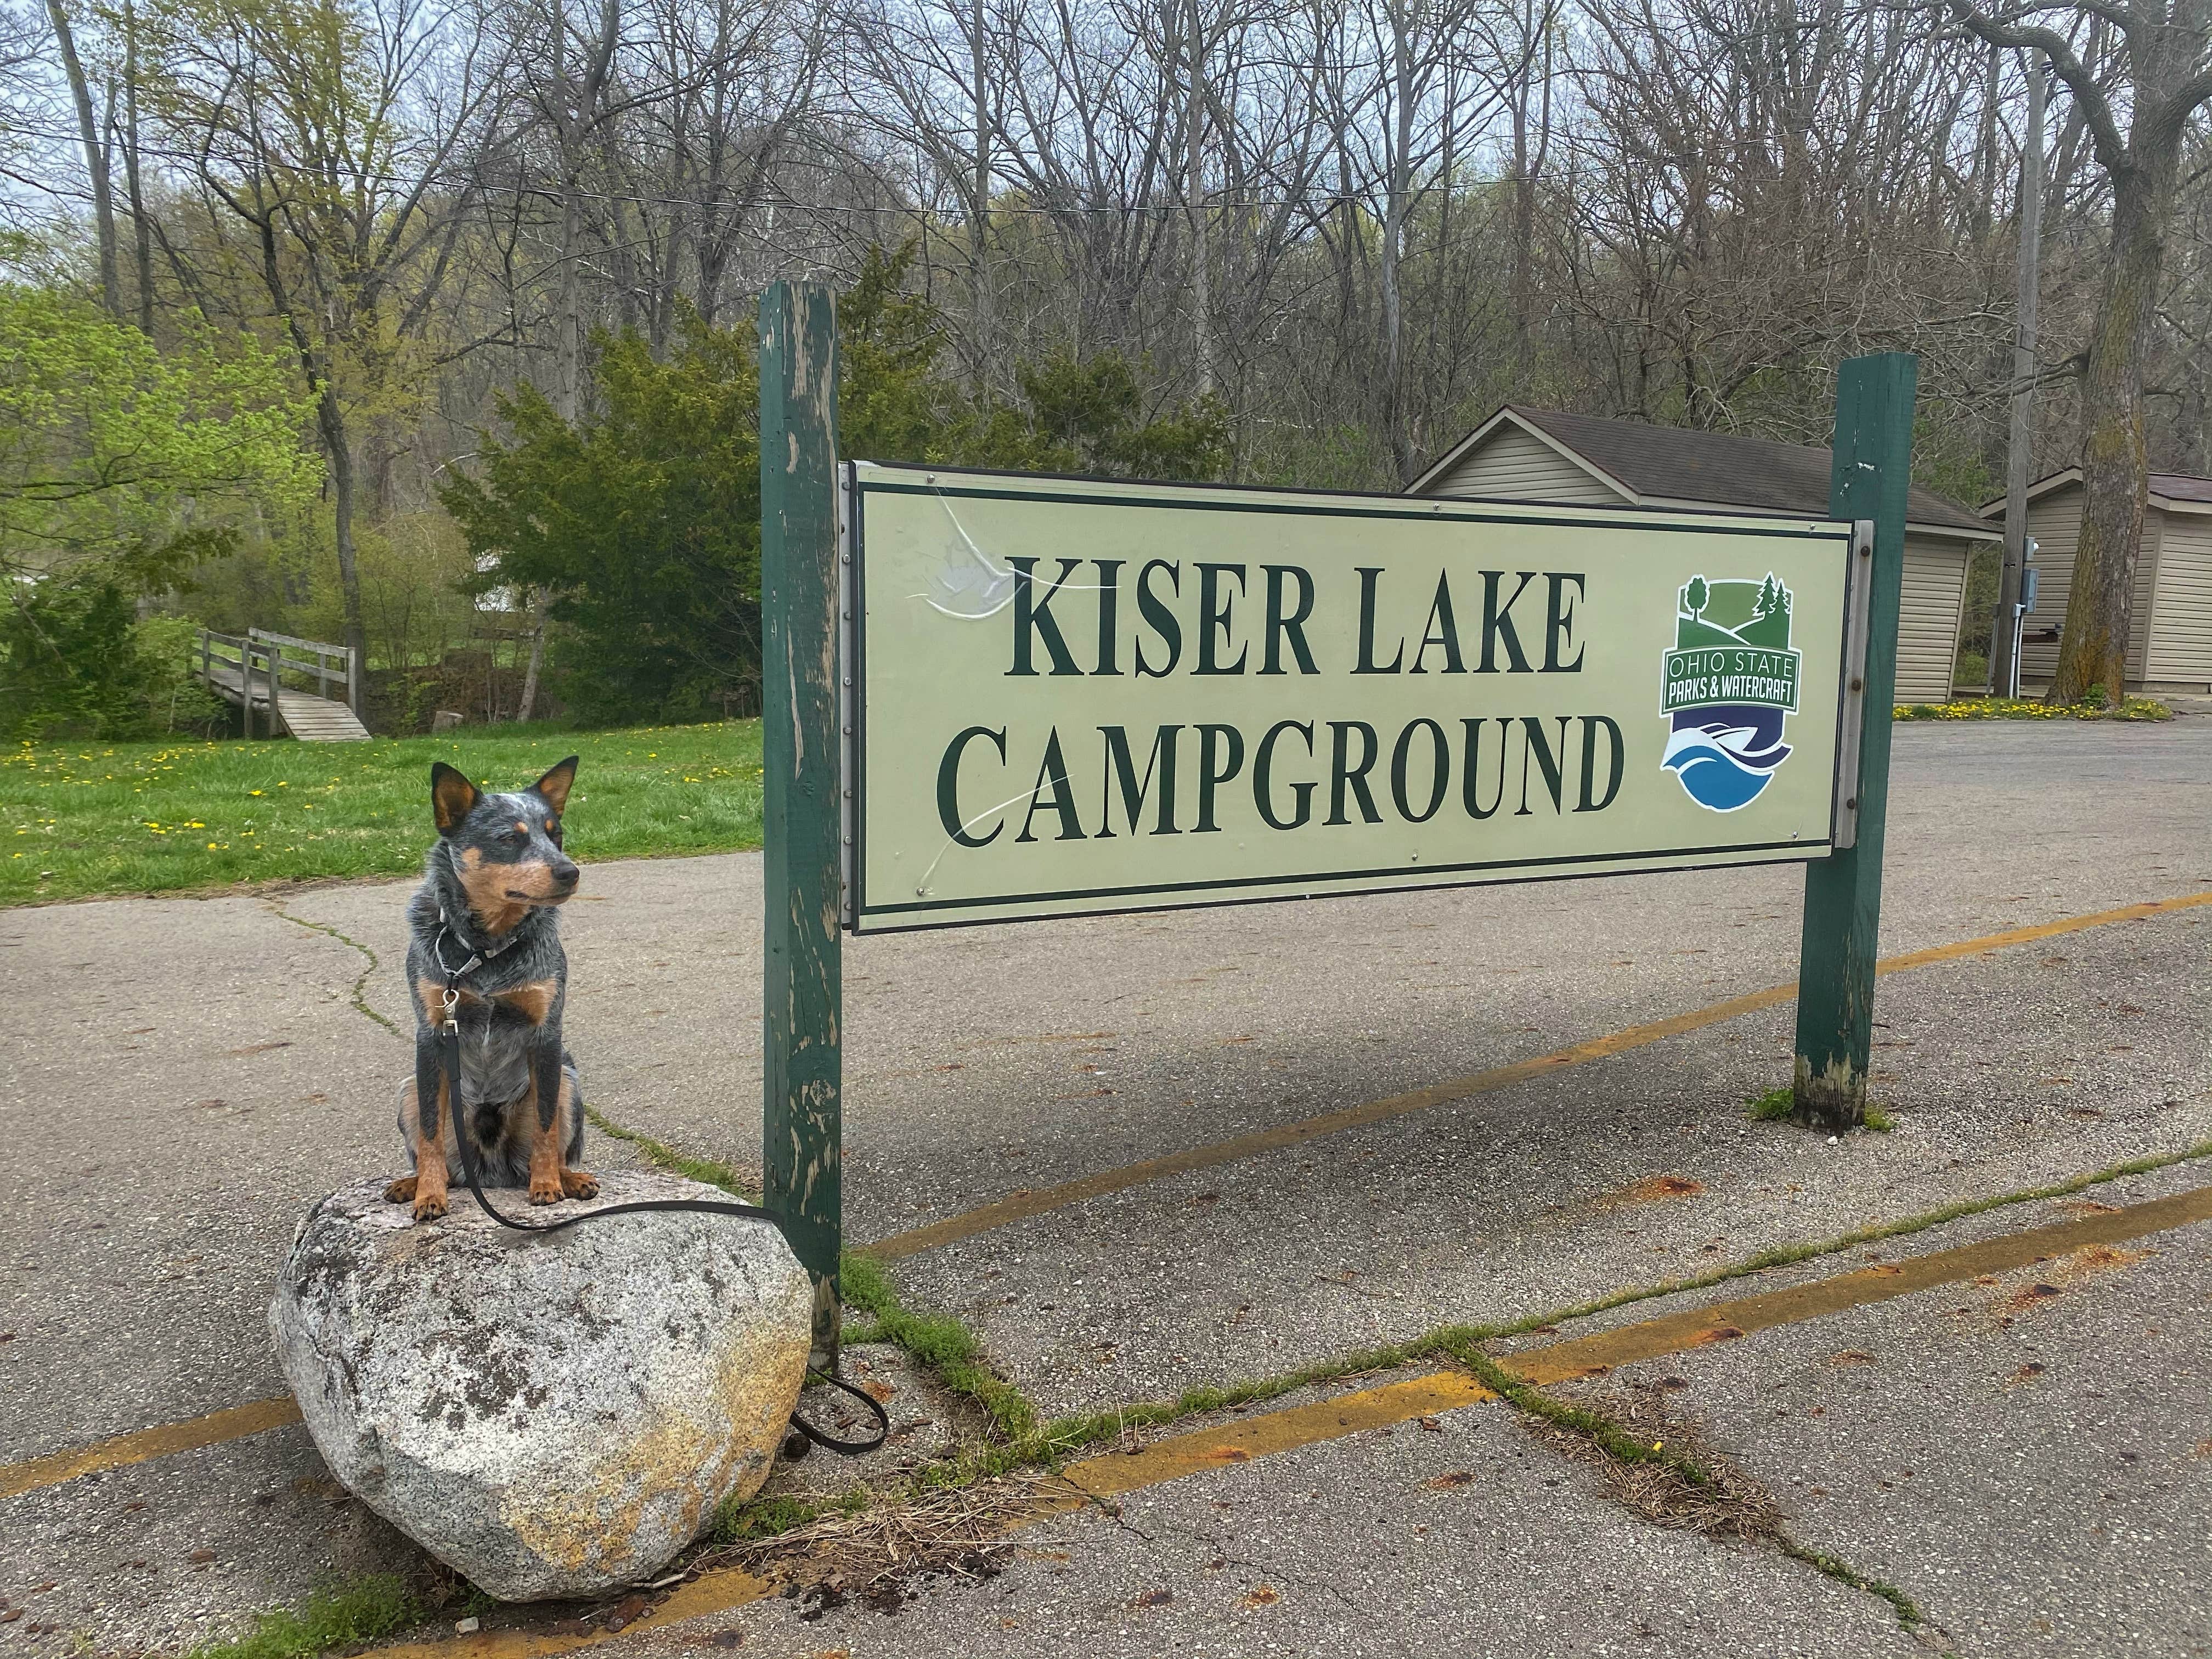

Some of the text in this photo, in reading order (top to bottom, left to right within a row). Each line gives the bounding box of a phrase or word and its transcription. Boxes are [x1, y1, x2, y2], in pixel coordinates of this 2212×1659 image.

[1003, 555, 1586, 678] KISER LAKE
[1668, 675, 1793, 704] PARKS & WATERCRAFT
[1669, 652, 1793, 678] OHIO STATE
[936, 715, 1624, 848] CAMPGROUND
